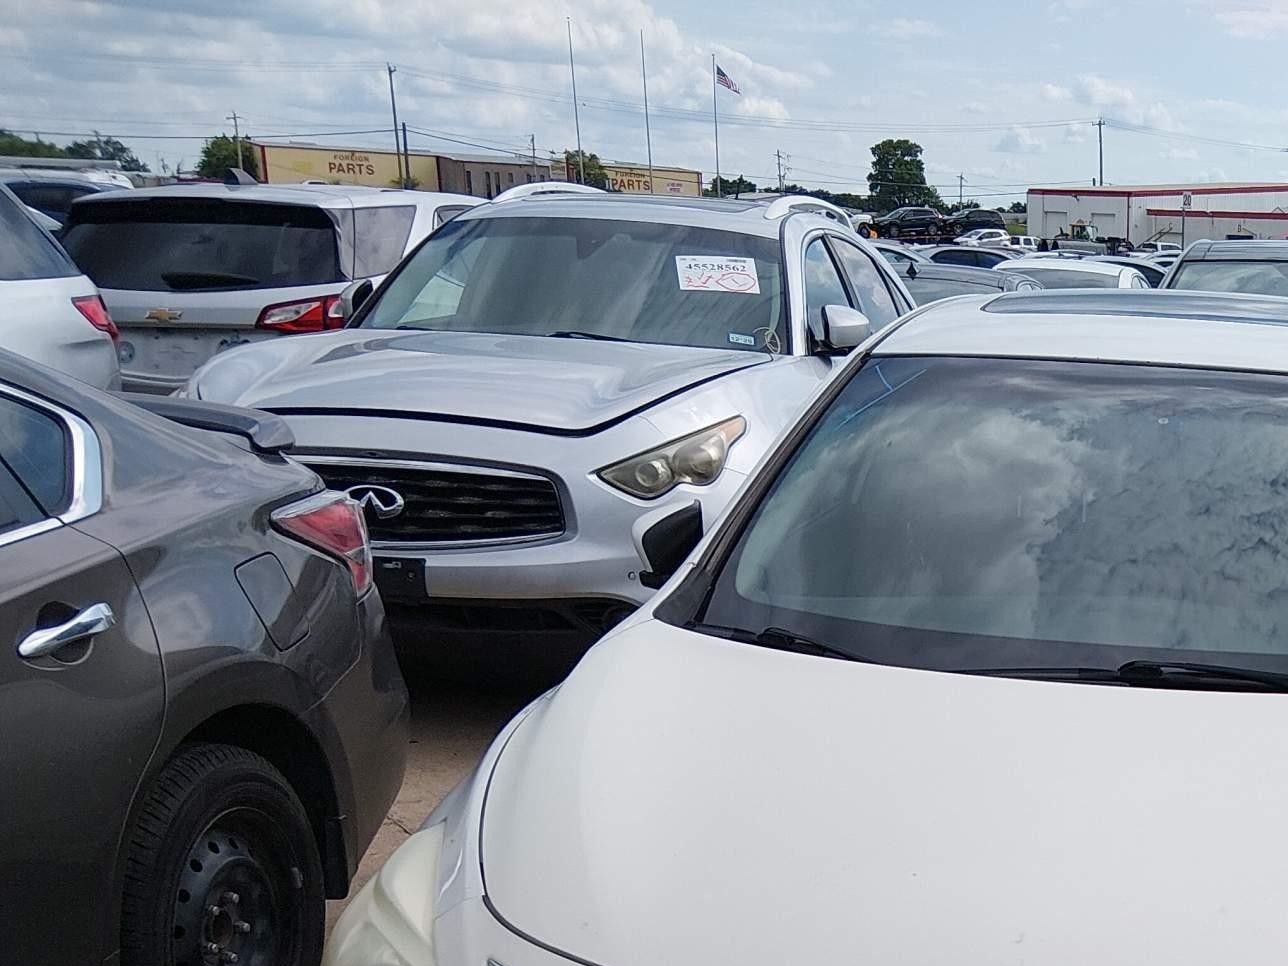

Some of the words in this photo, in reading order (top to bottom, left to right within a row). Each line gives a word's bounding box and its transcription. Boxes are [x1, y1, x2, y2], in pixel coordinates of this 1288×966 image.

[328, 161, 376, 176] PARTS
[612, 178, 650, 191] PARTS
[1183, 193, 1192, 206] 20
